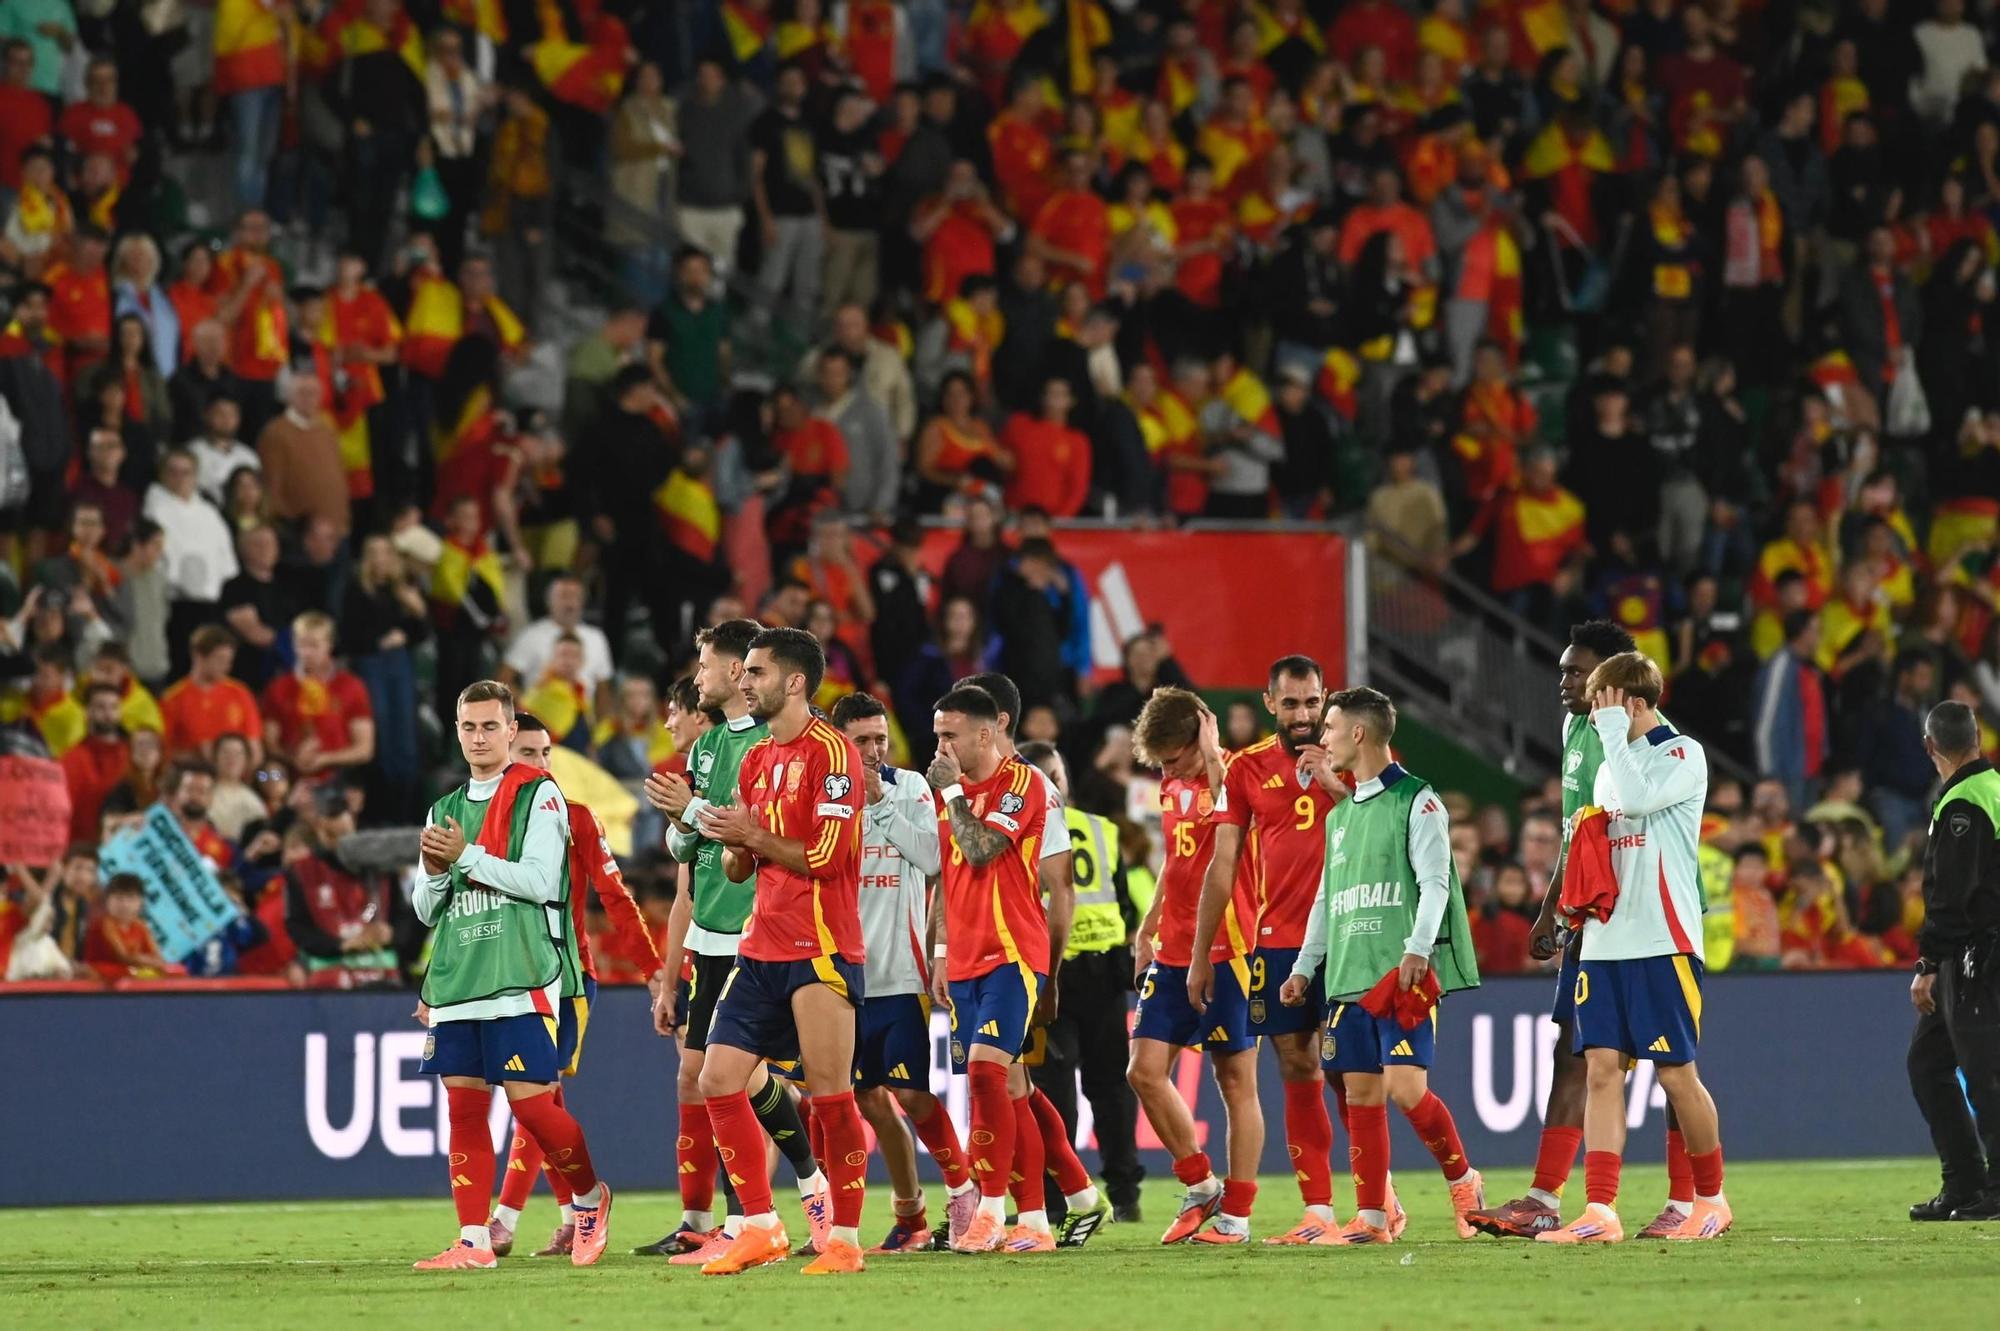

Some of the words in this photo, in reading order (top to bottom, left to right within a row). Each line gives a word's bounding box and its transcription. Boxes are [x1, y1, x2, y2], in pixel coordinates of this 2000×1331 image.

[765, 799, 785, 838] 11
[1295, 795, 1315, 831] 9
[1172, 821, 1196, 857] 15
[1069, 828, 1095, 887] 6
[1330, 882, 1403, 918] #FOOTBALL
[1250, 956, 1265, 992] 9
